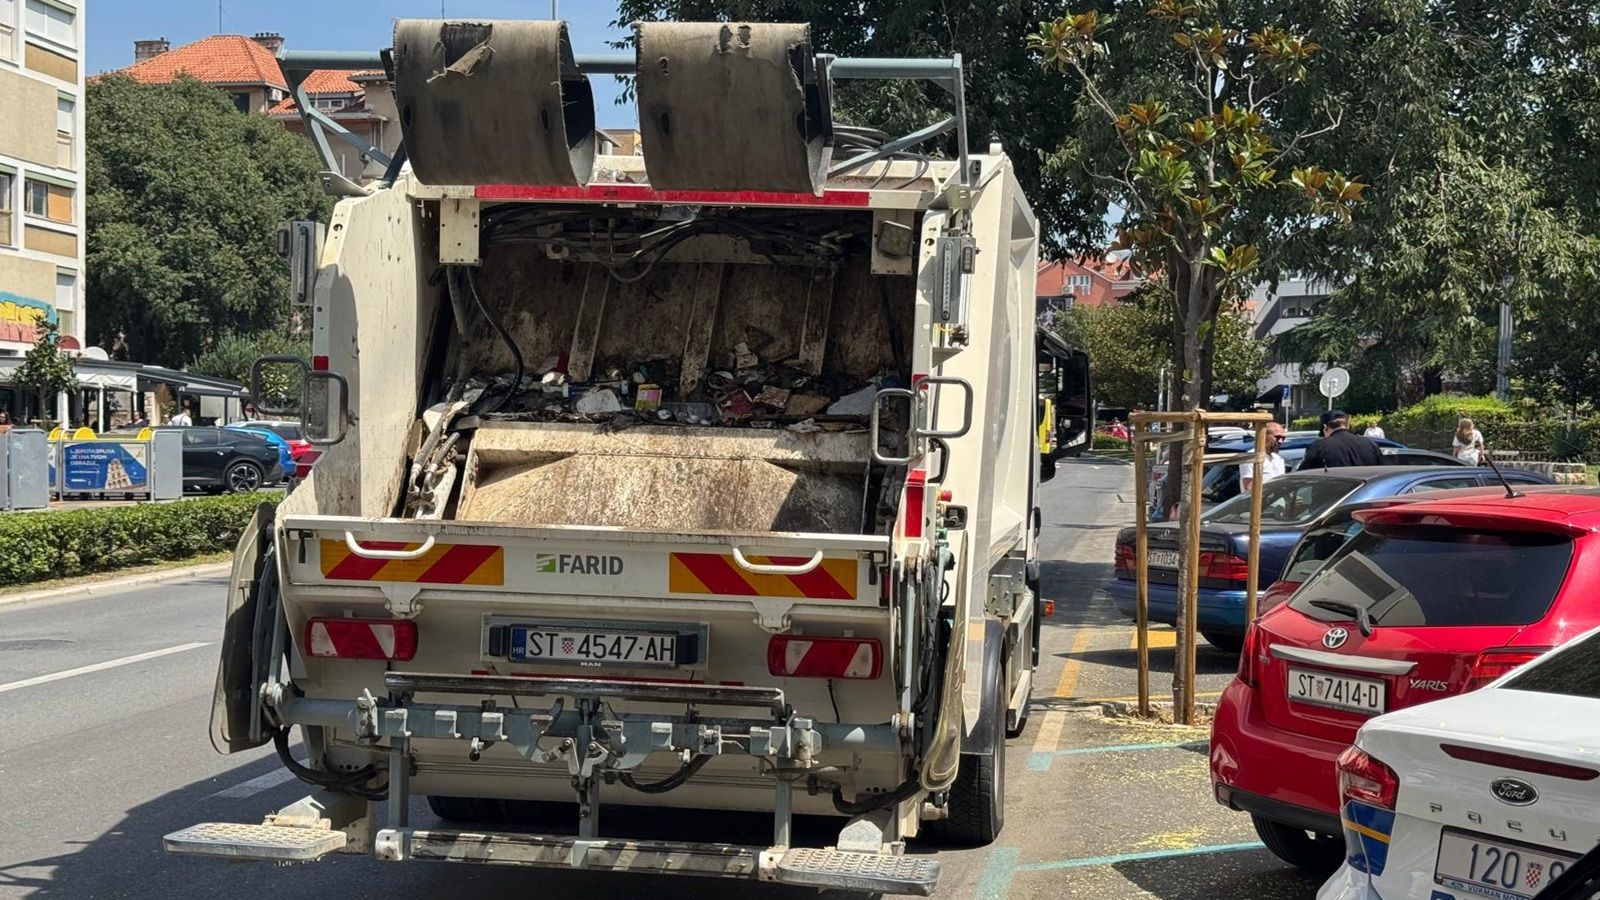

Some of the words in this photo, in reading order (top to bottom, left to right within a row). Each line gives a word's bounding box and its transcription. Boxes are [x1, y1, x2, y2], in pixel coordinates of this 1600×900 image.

[559, 554, 624, 576] FARID
[512, 646, 525, 655] HR
[529, 632, 558, 656] ST
[1298, 673, 1315, 698] ST
[1410, 678, 1449, 692] YARIS
[1498, 783, 1526, 800] Ford
[1468, 843, 1520, 889] 120
